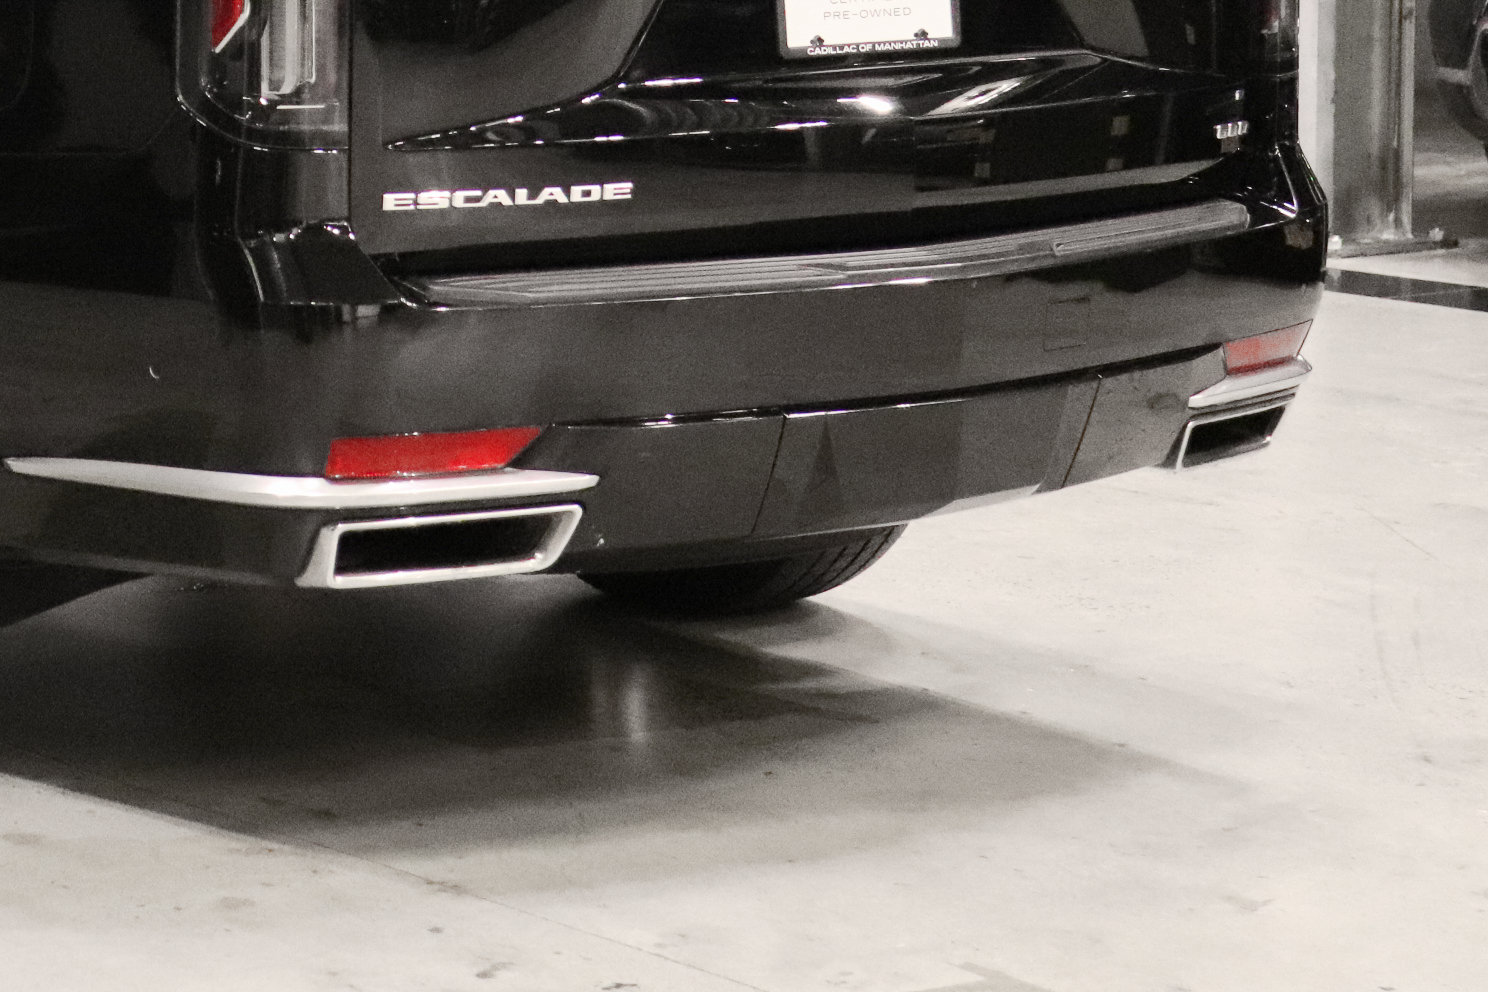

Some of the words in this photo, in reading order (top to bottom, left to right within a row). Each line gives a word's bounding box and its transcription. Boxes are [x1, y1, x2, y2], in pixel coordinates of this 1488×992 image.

[823, 7, 912, 20] PRE-OWNED
[807, 45, 857, 55] CADILLAC
[859, 44, 873, 52] OF
[875, 40, 938, 51] MANHATTAN
[383, 182, 633, 210] ESCALADE
